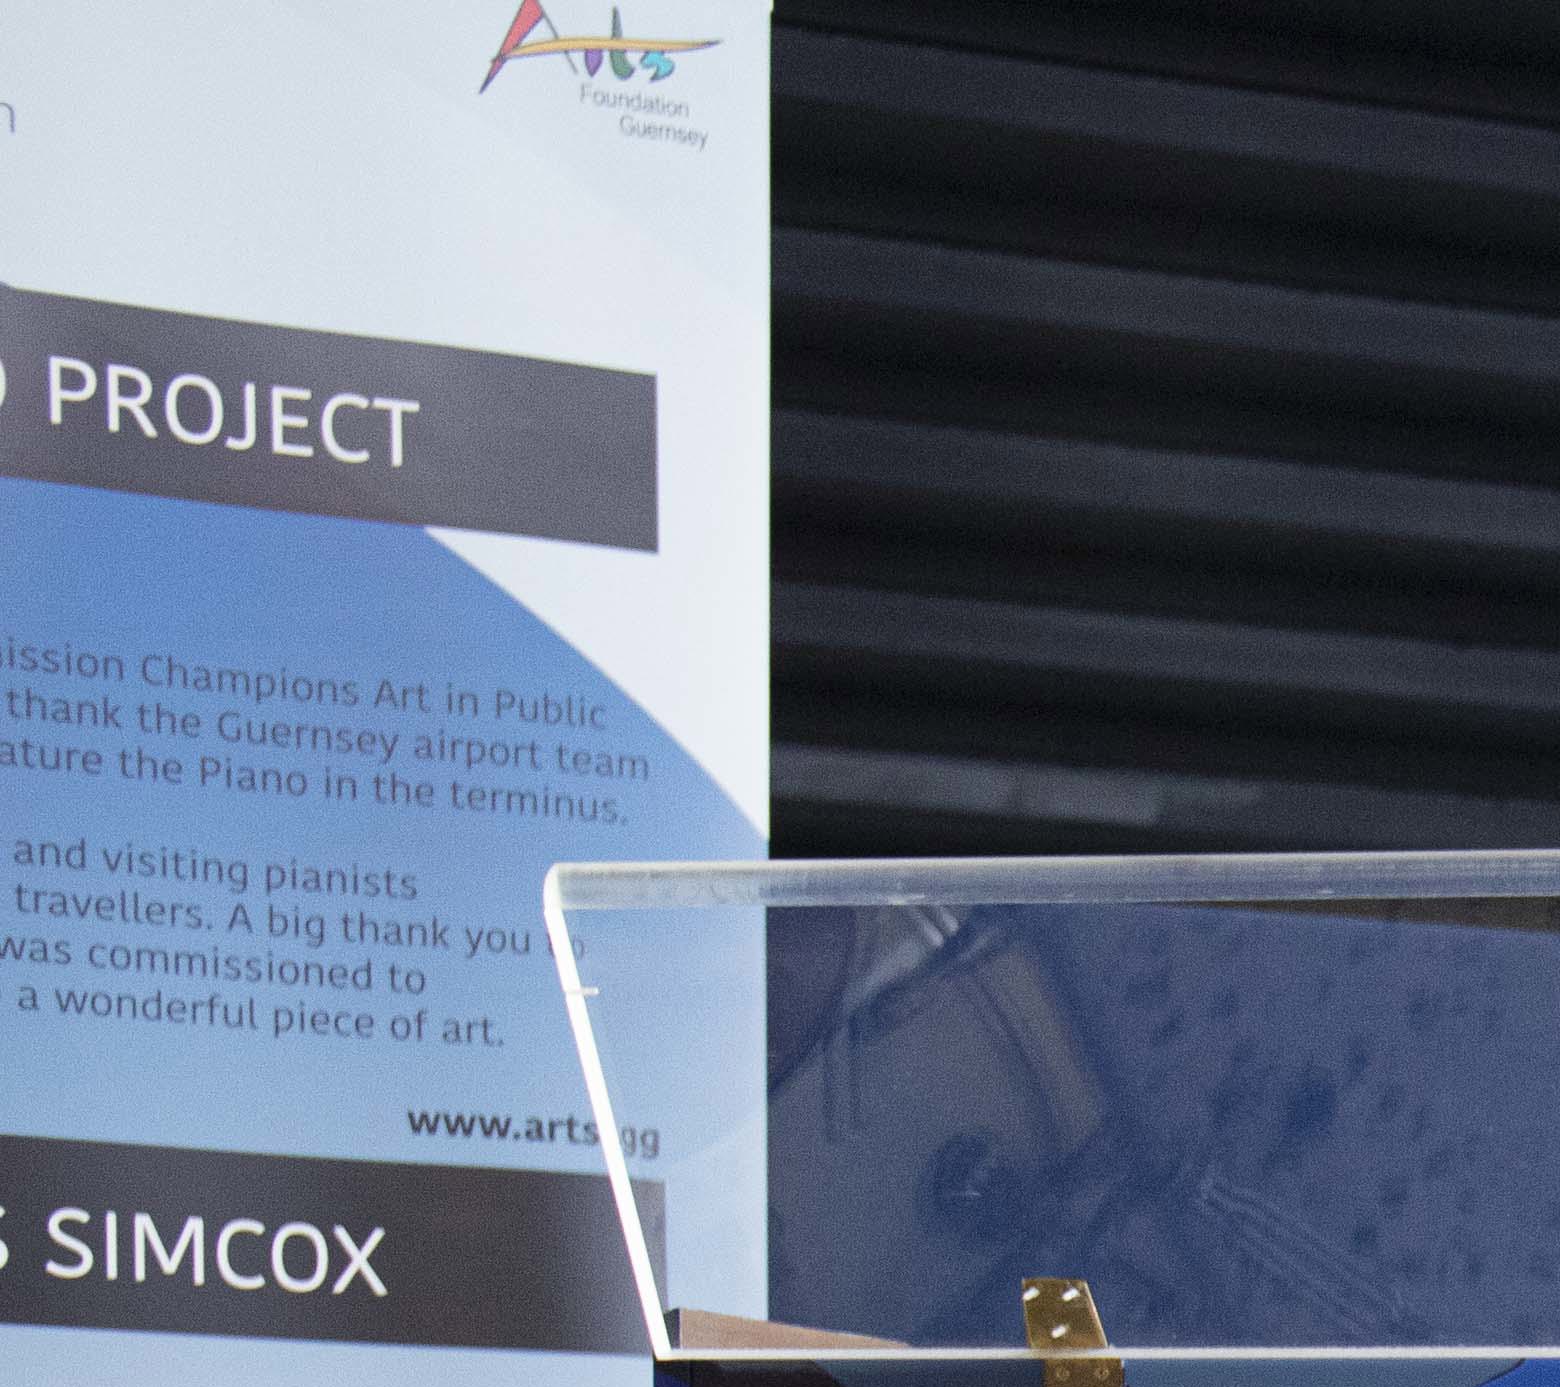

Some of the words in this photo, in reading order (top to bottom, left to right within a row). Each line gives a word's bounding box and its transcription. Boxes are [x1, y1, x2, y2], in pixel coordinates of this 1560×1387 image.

[579, 82, 689, 118] Foundation
[619, 115, 708, 152] Guernsey
[48, 355, 420, 468] PROJECT
[0, 637, 124, 681] ission
[141, 653, 358, 706] Champions
[374, 679, 431, 714] Art
[447, 682, 479, 717] in
[495, 688, 606, 730] Public
[6, 687, 122, 730] thank
[137, 702, 201, 738] the
[218, 711, 400, 764] Guernsey
[414, 729, 542, 769] airport
[556, 744, 650, 780] team
[120, 748, 183, 785] the
[200, 757, 308, 797] Piano
[324, 767, 357, 801] in
[373, 773, 434, 808] the
[451, 781, 630, 825] terminus.
[13, 839, 86, 870] and
[103, 844, 249, 895] visiting
[265, 856, 418, 900] pianists
[15, 882, 214, 931] travellers.
[227, 902, 252, 933] A
[269, 904, 326, 948] big
[342, 911, 450, 947] thank
[465, 925, 530, 960] you
[0, 935, 72, 966] was
[88, 942, 372, 990] commissioned
[390, 964, 425, 994] to
[17, 986, 39, 1011] a
[55, 987, 257, 1030] wonderful
[273, 1003, 375, 1038] piece
[389, 1009, 428, 1042] of
[442, 1016, 504, 1048] art.
[407, 1109, 660, 1160] www.artsgg
[45, 1206, 389, 1297] SIMCOX
